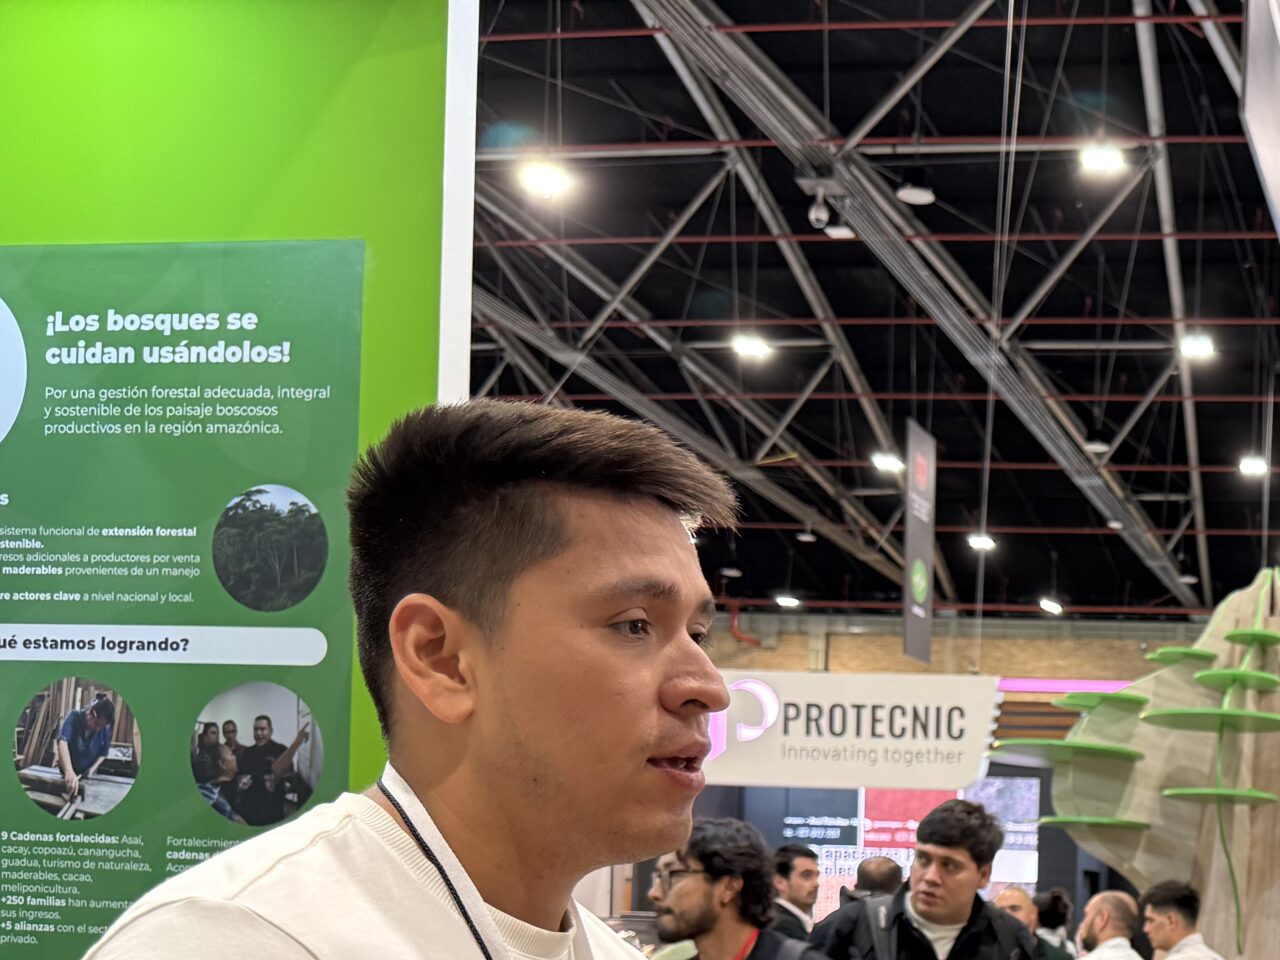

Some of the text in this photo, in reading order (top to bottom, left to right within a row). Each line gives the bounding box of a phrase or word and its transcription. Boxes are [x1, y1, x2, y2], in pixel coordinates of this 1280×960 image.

[46, 309, 259, 336] ¡Los bosques se
[45, 340, 291, 364] cuidan usándolos!
[45, 385, 331, 403] Por una gestión forestal adecuada, integral
[43, 403, 279, 419] y sostenible de los paisaje boscosos
[44, 420, 283, 437] productivos en la región amazónica.
[0, 525, 197, 537] sistema funcional de extensión forestal
[26, 552, 81, 562] adicionales
[91, 553, 151, 565] productores
[153, 555, 170, 565] por
[172, 554, 200, 564] venta
[2, 565, 201, 578] maderables provenientes de un manejo
[12, 592, 51, 601] actores
[53, 591, 81, 601] clave
[91, 591, 115, 602] nivel
[117, 591, 159, 602] nacional
[160, 595, 167, 604] y
[168, 592, 195, 603] local.
[22, 636, 96, 651] estamos
[101, 636, 190, 654] logrando?
[782, 702, 966, 740] PROTECNIC
[781, 742, 965, 767] Innovating together
[1, 830, 8, 839] 9
[10, 831, 54, 842] Cadenas
[55, 831, 119, 844] fortalecidas:
[1, 845, 142, 859] cacay, copoazú, canangucha,
[166, 849, 210, 860] cadenas
[1, 858, 152, 872] guadua, turismo de naturaleza,
[1, 870, 93, 883] maderables, cacao,
[1, 882, 80, 895] meliponicultura.
[1, 895, 24, 905] +250
[26, 896, 66, 907] familias
[68, 897, 87, 908] han
[0, 908, 61, 920] sus ingresos.
[1, 921, 12, 930] +5
[14, 921, 55, 932] alianzas
[57, 924, 75, 933] con
[77, 924, 86, 933] el
[0, 934, 38, 945] privado.
